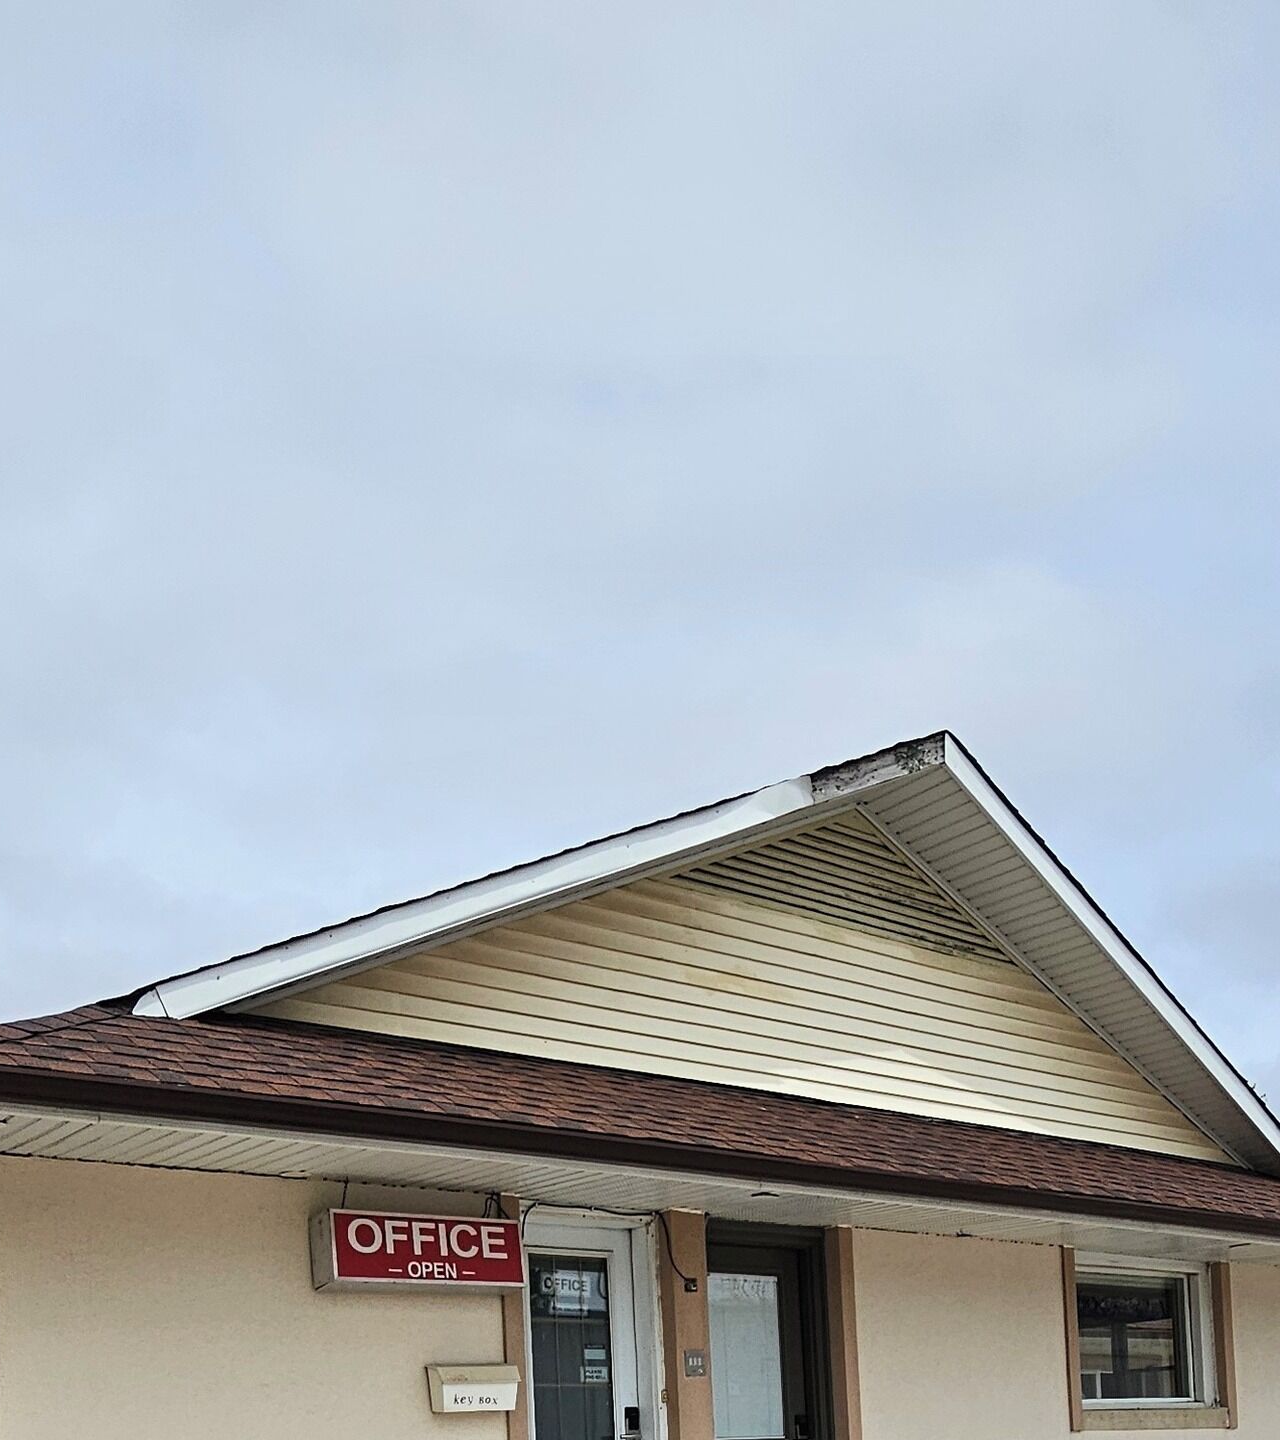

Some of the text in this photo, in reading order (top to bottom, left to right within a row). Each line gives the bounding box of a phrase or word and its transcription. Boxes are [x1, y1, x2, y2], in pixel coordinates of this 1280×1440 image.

[347, 1217, 509, 1260] OFFICE
[407, 1261, 458, 1279] OPEN
[543, 1276, 589, 1293] OFFICE
[453, 1393, 474, 1405] key
